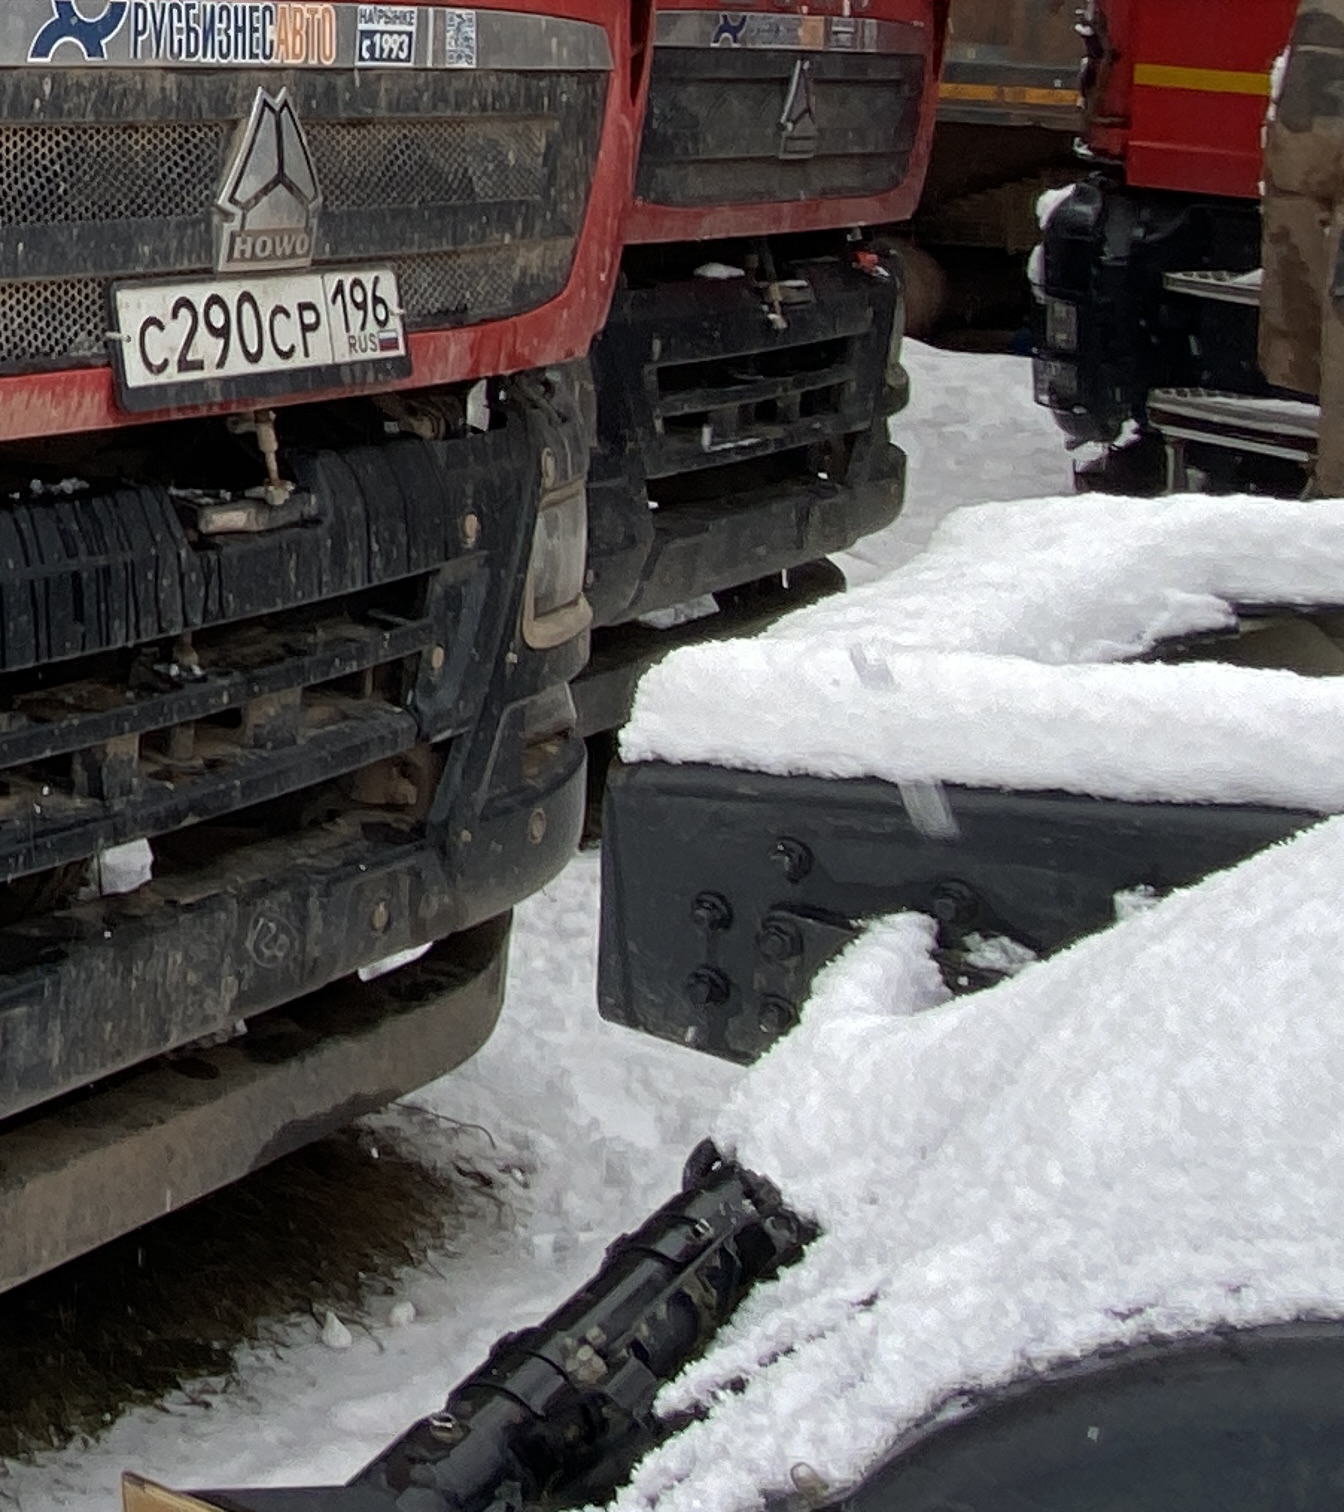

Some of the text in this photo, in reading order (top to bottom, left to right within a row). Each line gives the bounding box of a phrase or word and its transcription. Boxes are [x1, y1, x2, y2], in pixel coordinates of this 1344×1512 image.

[131, 0, 336, 64] РУСБИЗНЕСАВТО
[373, 32, 409, 59] 1993
[232, 234, 309, 260] HOWO
[330, 275, 389, 334] 196
[348, 331, 379, 354] RUS
